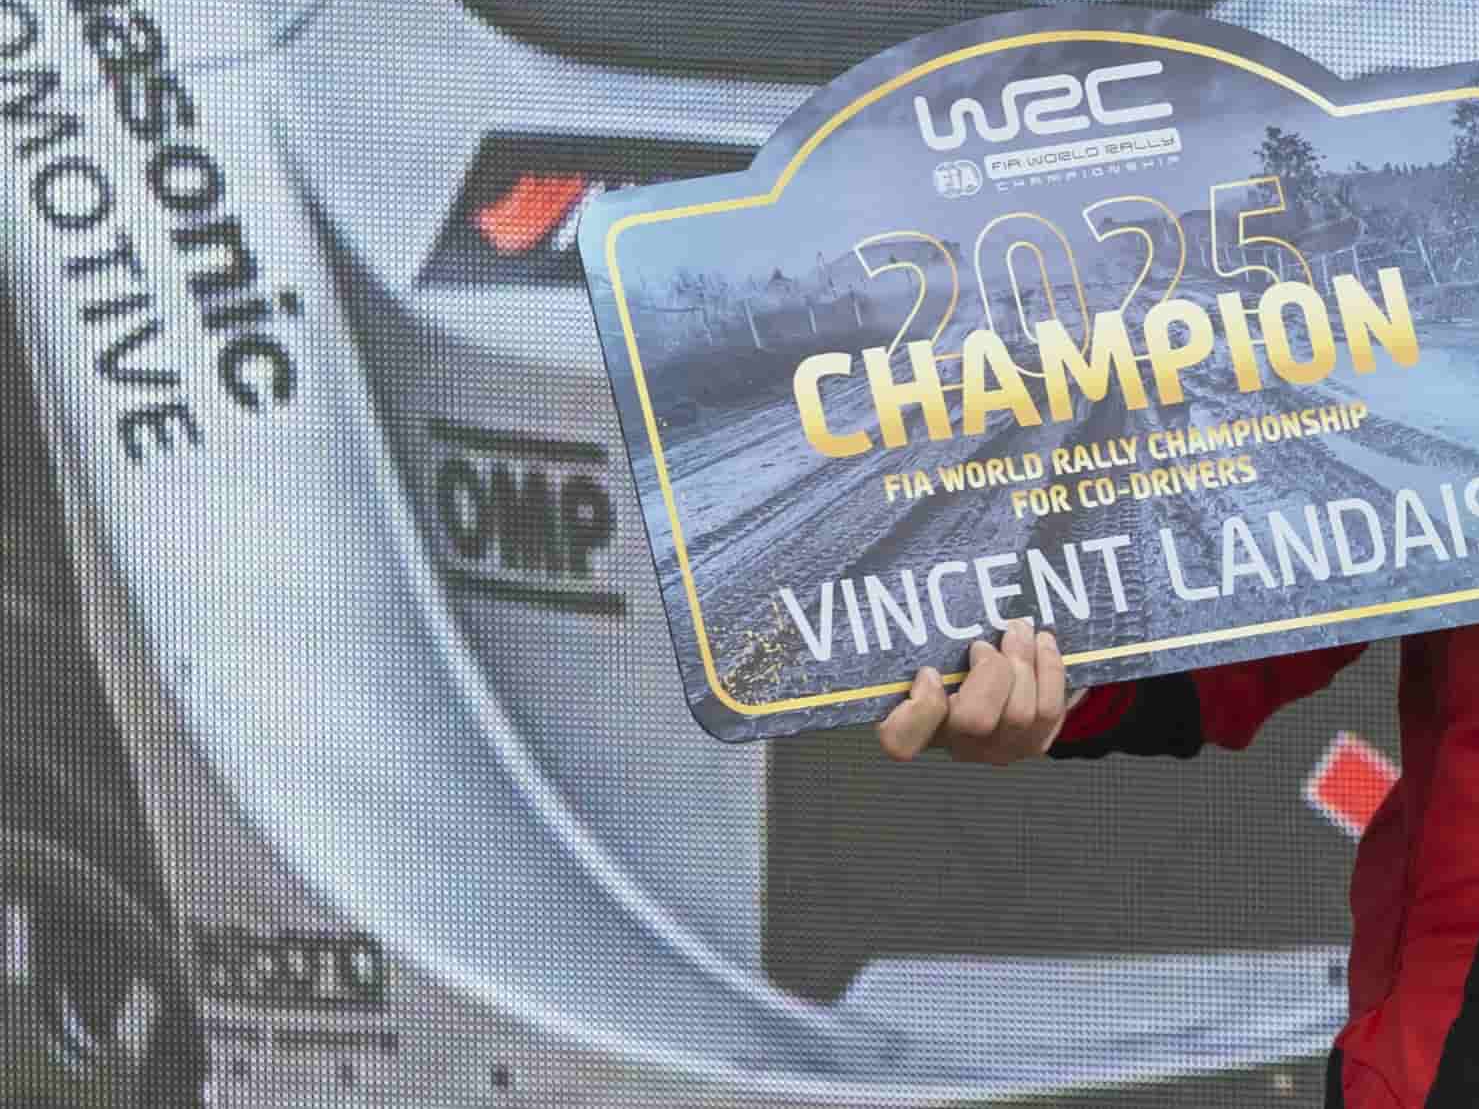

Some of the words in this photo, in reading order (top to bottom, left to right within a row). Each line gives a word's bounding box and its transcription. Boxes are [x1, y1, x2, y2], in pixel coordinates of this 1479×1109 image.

[914, 59, 1174, 150] WRC
[1026, 147, 1100, 167] WORLD
[1105, 136, 1175, 156] RALLY
[856, 176, 1313, 390] 2025
[793, 267, 1421, 458] CHAMPION
[883, 472, 935, 504] FIA
[939, 452, 1045, 492] WORLD
[1051, 436, 1139, 475] RALLY
[1147, 403, 1368, 461] CHAMPIONSHIP
[1010, 483, 1072, 520] FOR
[1077, 454, 1257, 509] CO-DRIVERS
[436, 456, 617, 582] OMP
[783, 533, 1131, 663] VINCENT
